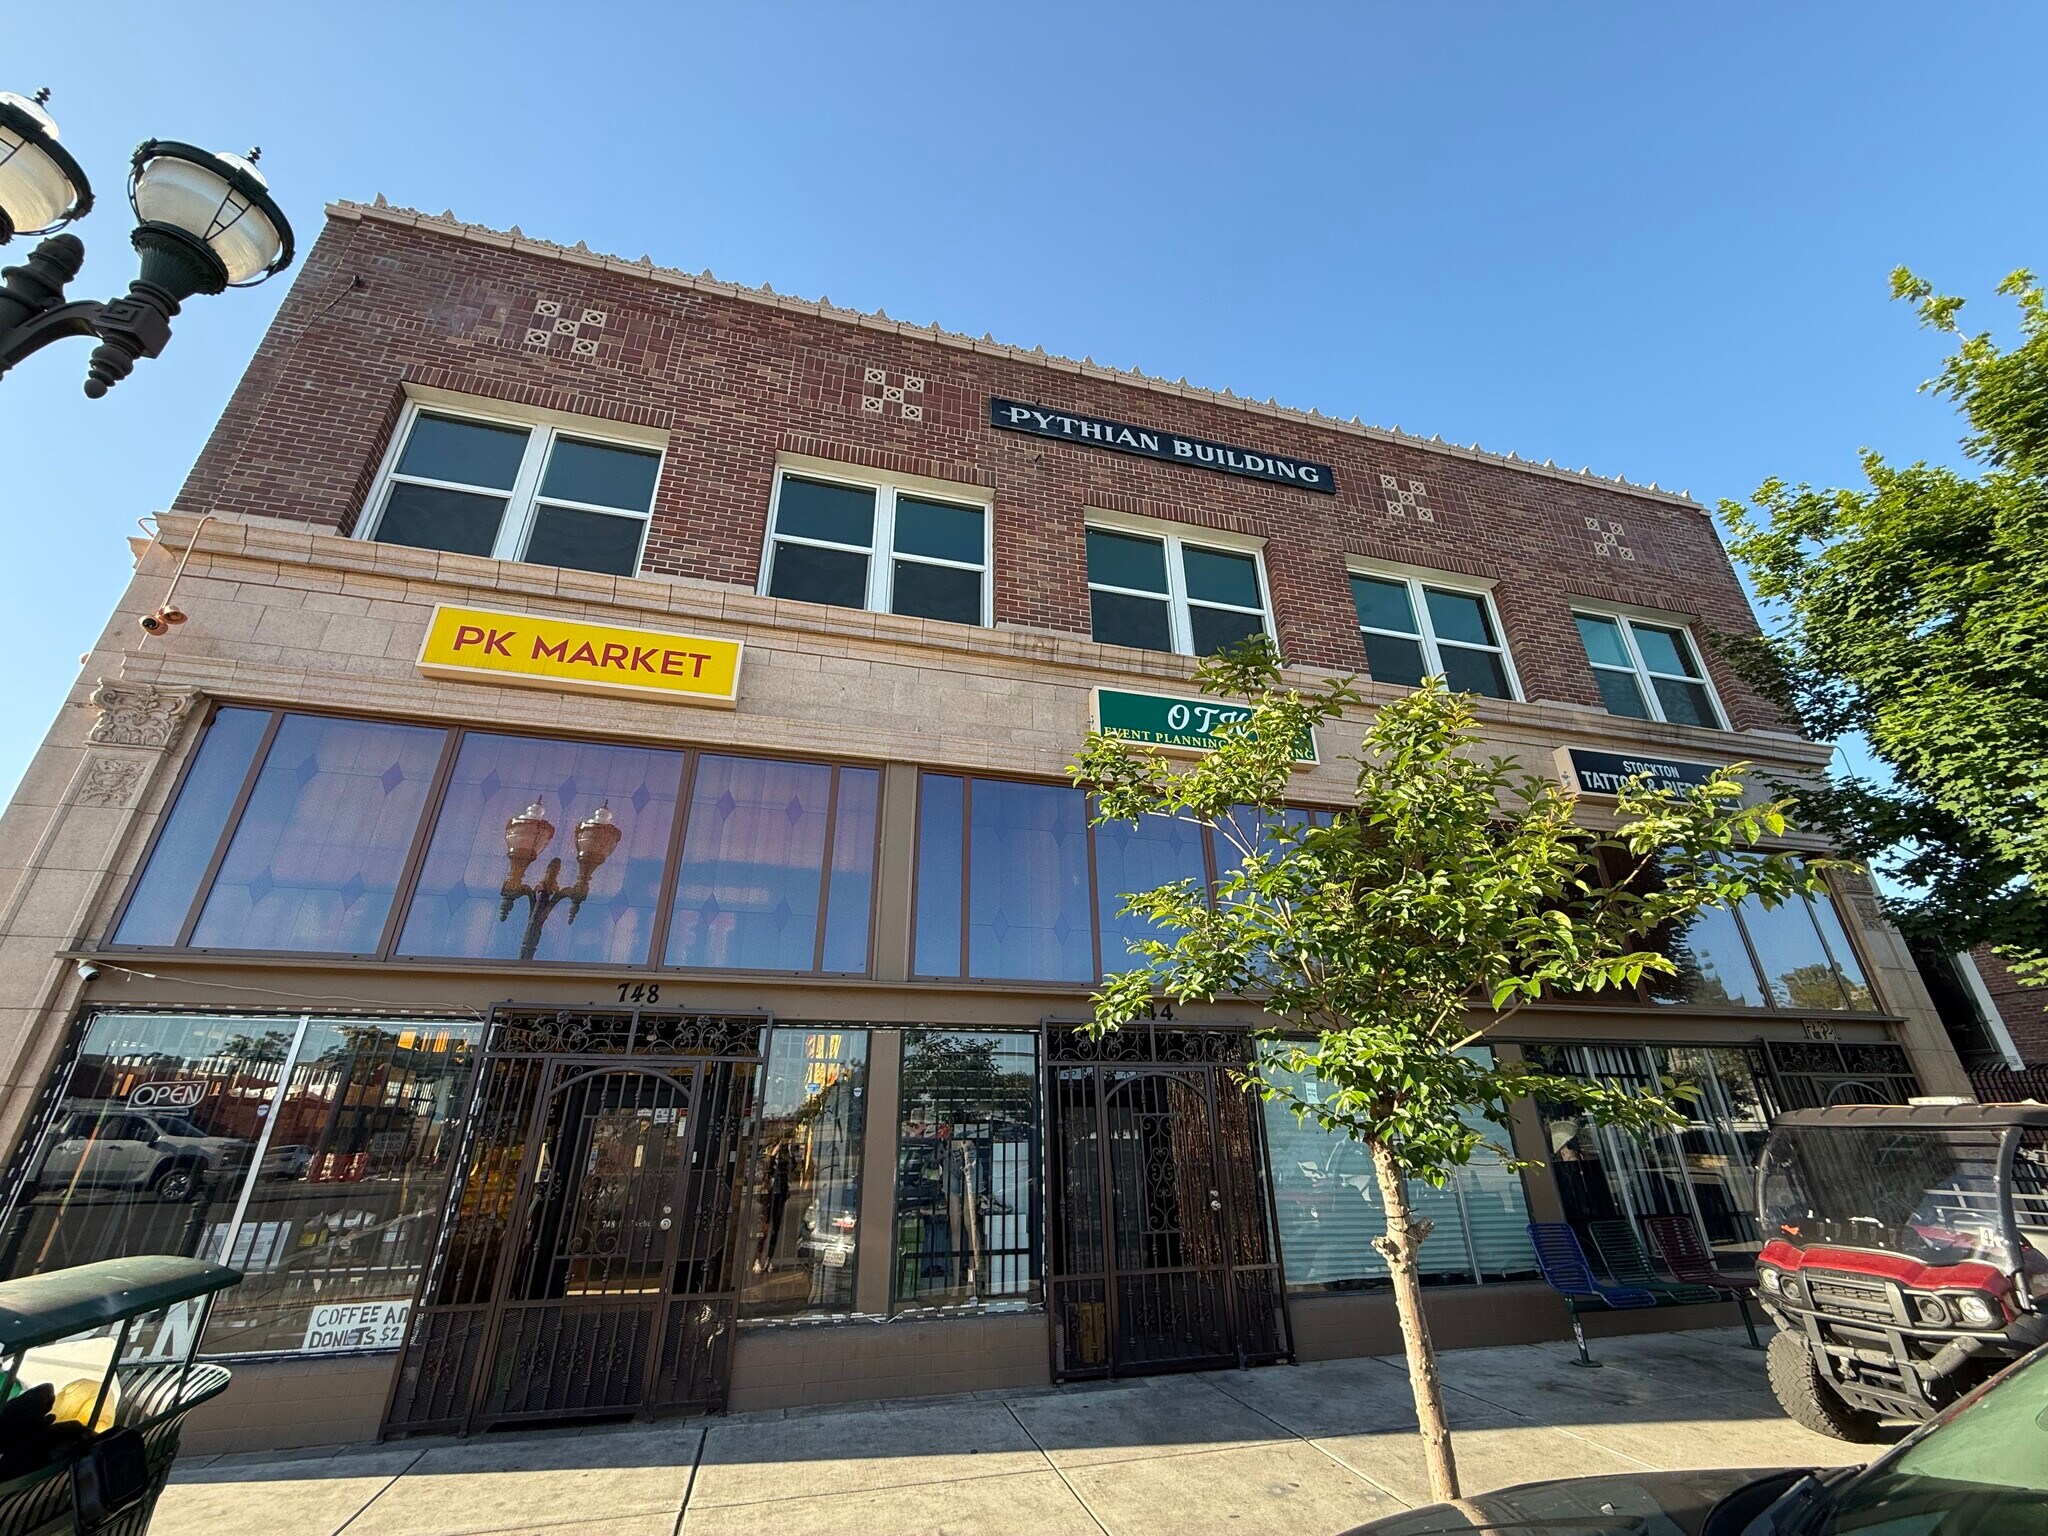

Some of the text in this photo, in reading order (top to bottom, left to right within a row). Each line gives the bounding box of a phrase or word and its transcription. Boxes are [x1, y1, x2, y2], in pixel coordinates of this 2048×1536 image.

[1009, 405, 1321, 484] PYTHIAN BUILDING
[453, 625, 712, 679] PK MARKET
[1103, 726, 1150, 741] EVENT
[1622, 760, 1680, 779] STOCKTON
[1580, 770, 1644, 795] TATTO
[1646, 778, 1660, 794] &
[618, 982, 659, 1004] 748
[134, 1085, 202, 1105] OPEN
[316, 1305, 383, 1328] COFFEE
